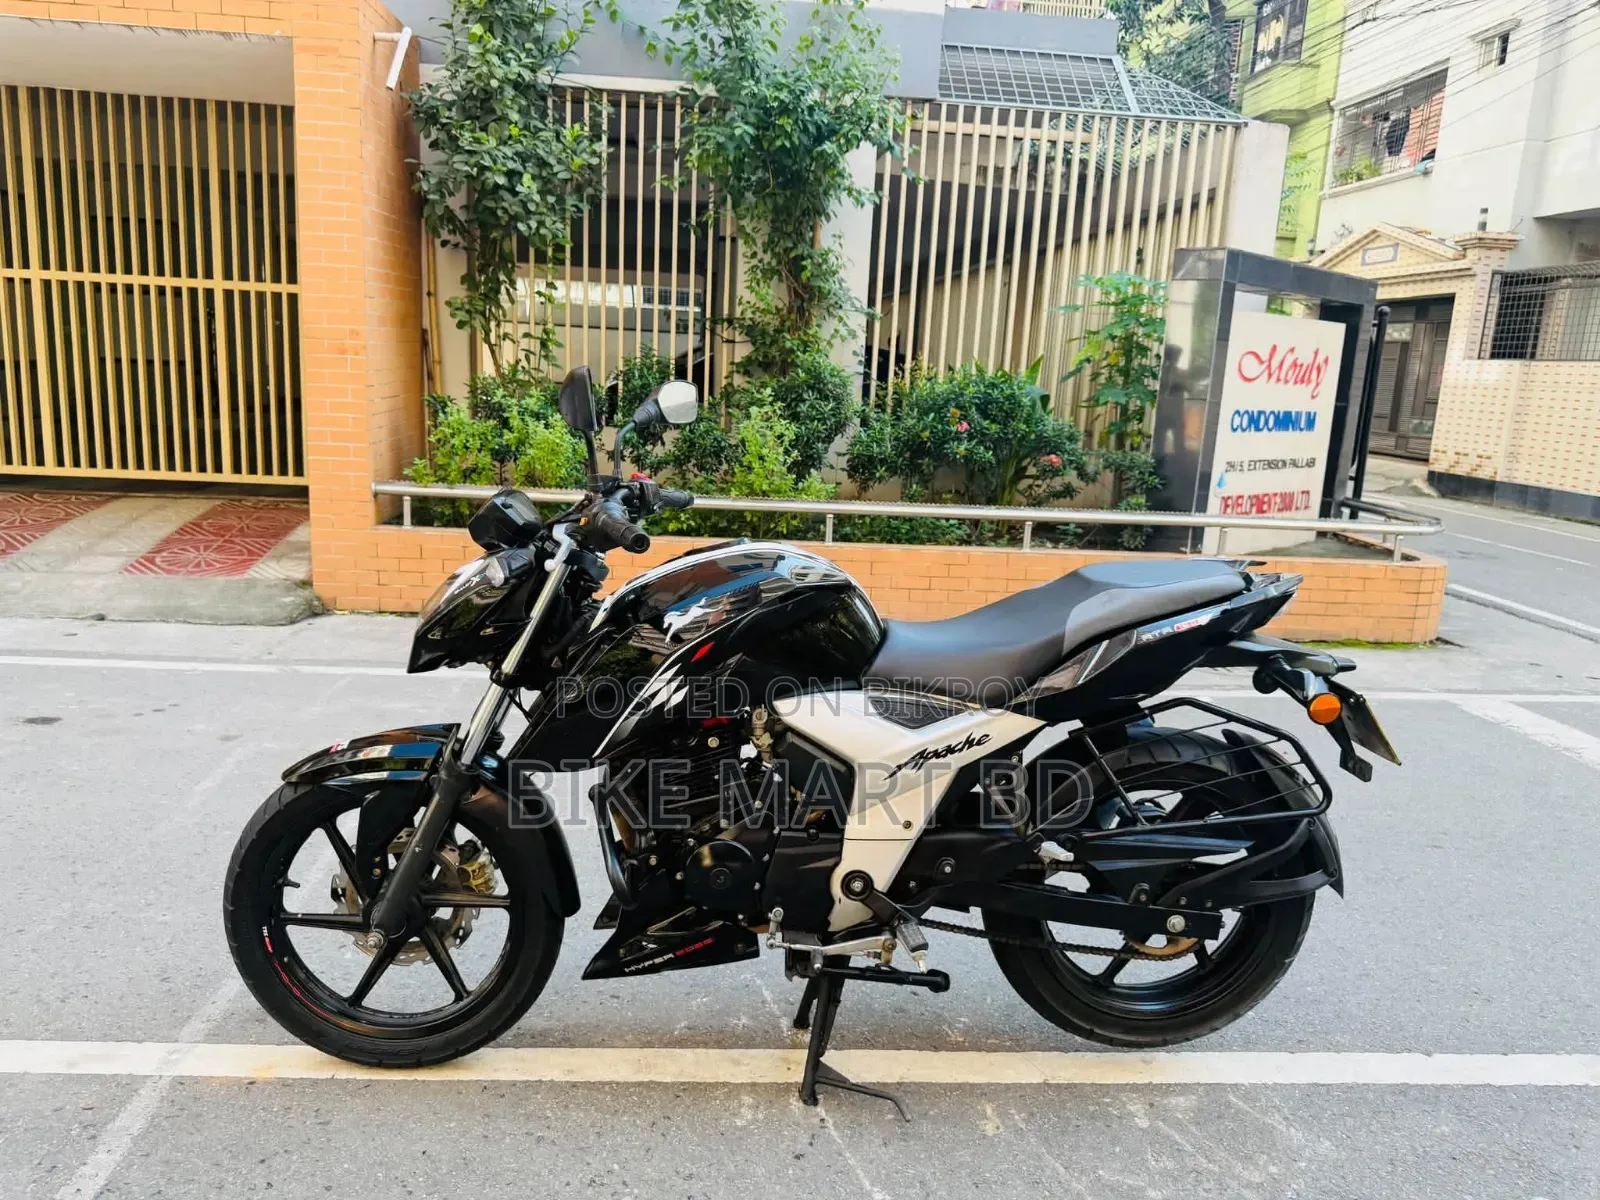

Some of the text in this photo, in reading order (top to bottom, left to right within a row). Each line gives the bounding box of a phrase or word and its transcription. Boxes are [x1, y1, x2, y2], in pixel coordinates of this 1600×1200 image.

[1237, 344, 1329, 399] Mouly
[1231, 409, 1317, 432] CONDOMINIUM
[1247, 459, 1287, 472] EXTENSION
[883, 731, 993, 780] Apache
